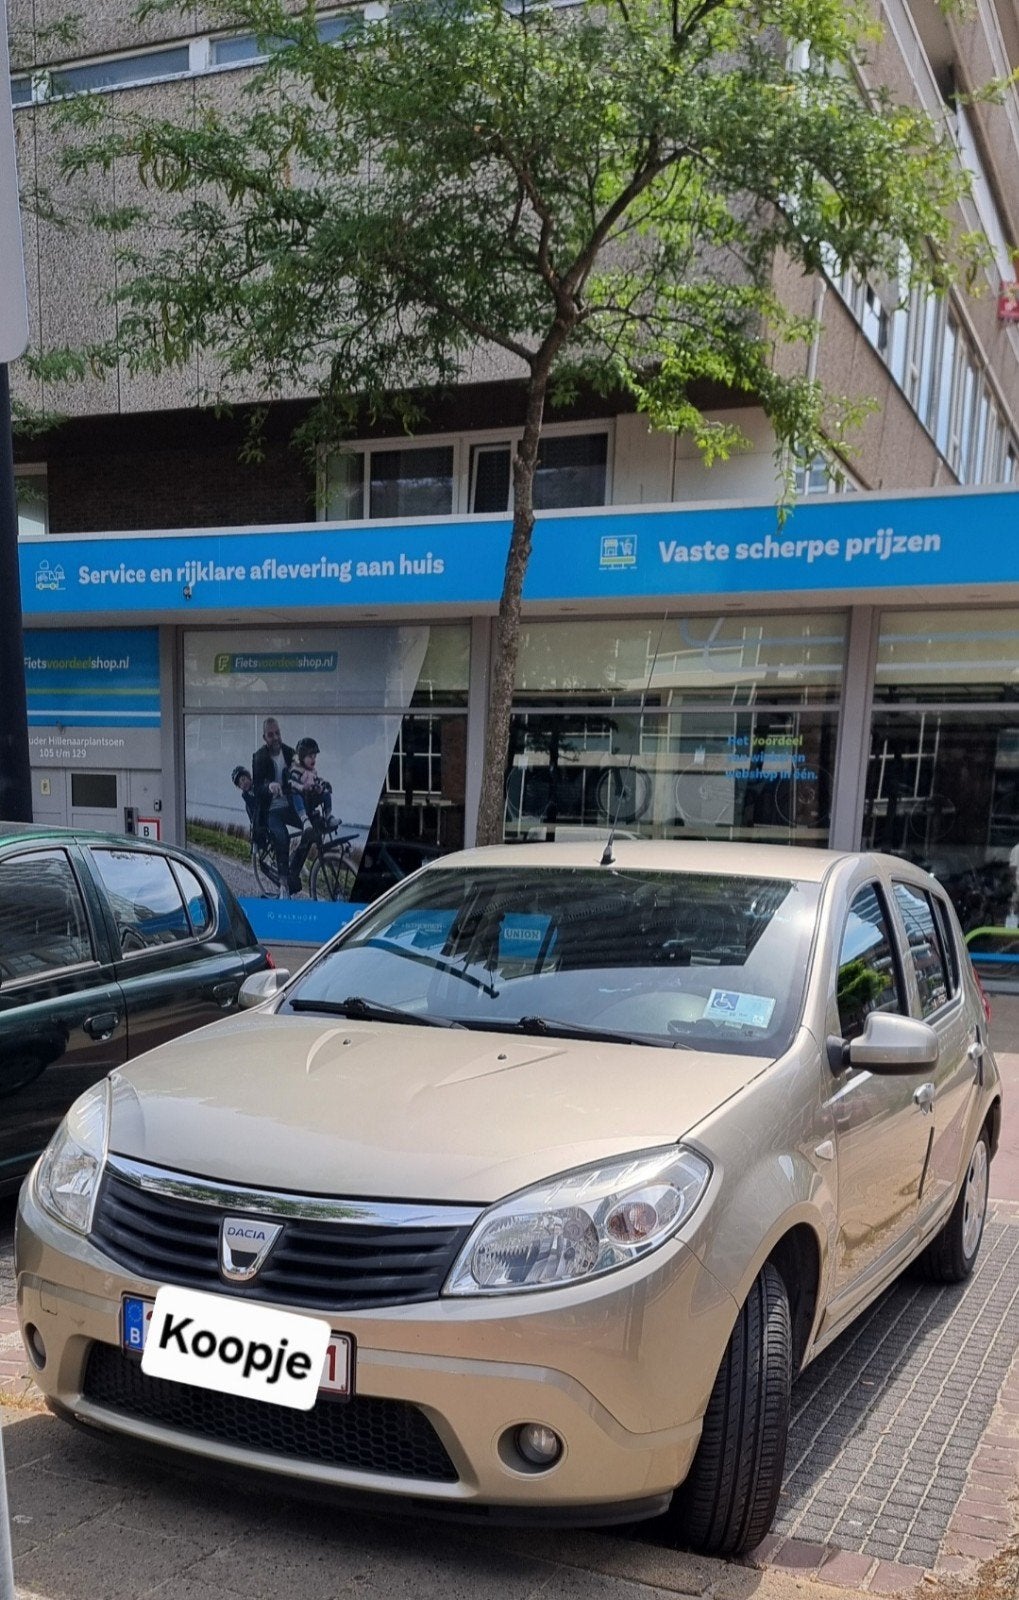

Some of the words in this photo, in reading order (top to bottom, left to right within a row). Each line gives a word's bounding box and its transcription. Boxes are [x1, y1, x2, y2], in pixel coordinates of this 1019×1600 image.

[659, 540, 729, 563] Vaste
[735, 535, 840, 563] scherpe
[845, 528, 941, 561] prijzen
[78, 562, 146, 584] Service
[150, 570, 173, 583] en
[176, 560, 246, 588] rijklare
[250, 556, 352, 583] aflevering
[356, 561, 395, 576] aan
[400, 552, 445, 574] huis
[49, 736, 125, 748] Hillenaarplantsoen
[727, 735, 749, 746] Het
[752, 734, 803, 746] voordeel
[39, 749, 54, 758] 105
[55, 749, 71, 758] t/m
[72, 749, 87, 758] 129
[725, 768, 778, 781] webshop
[143, 826, 150, 837] B
[506, 929, 540, 940] UNION
[227, 1226, 266, 1241] DACIA
[130, 1327, 141, 1344] B
